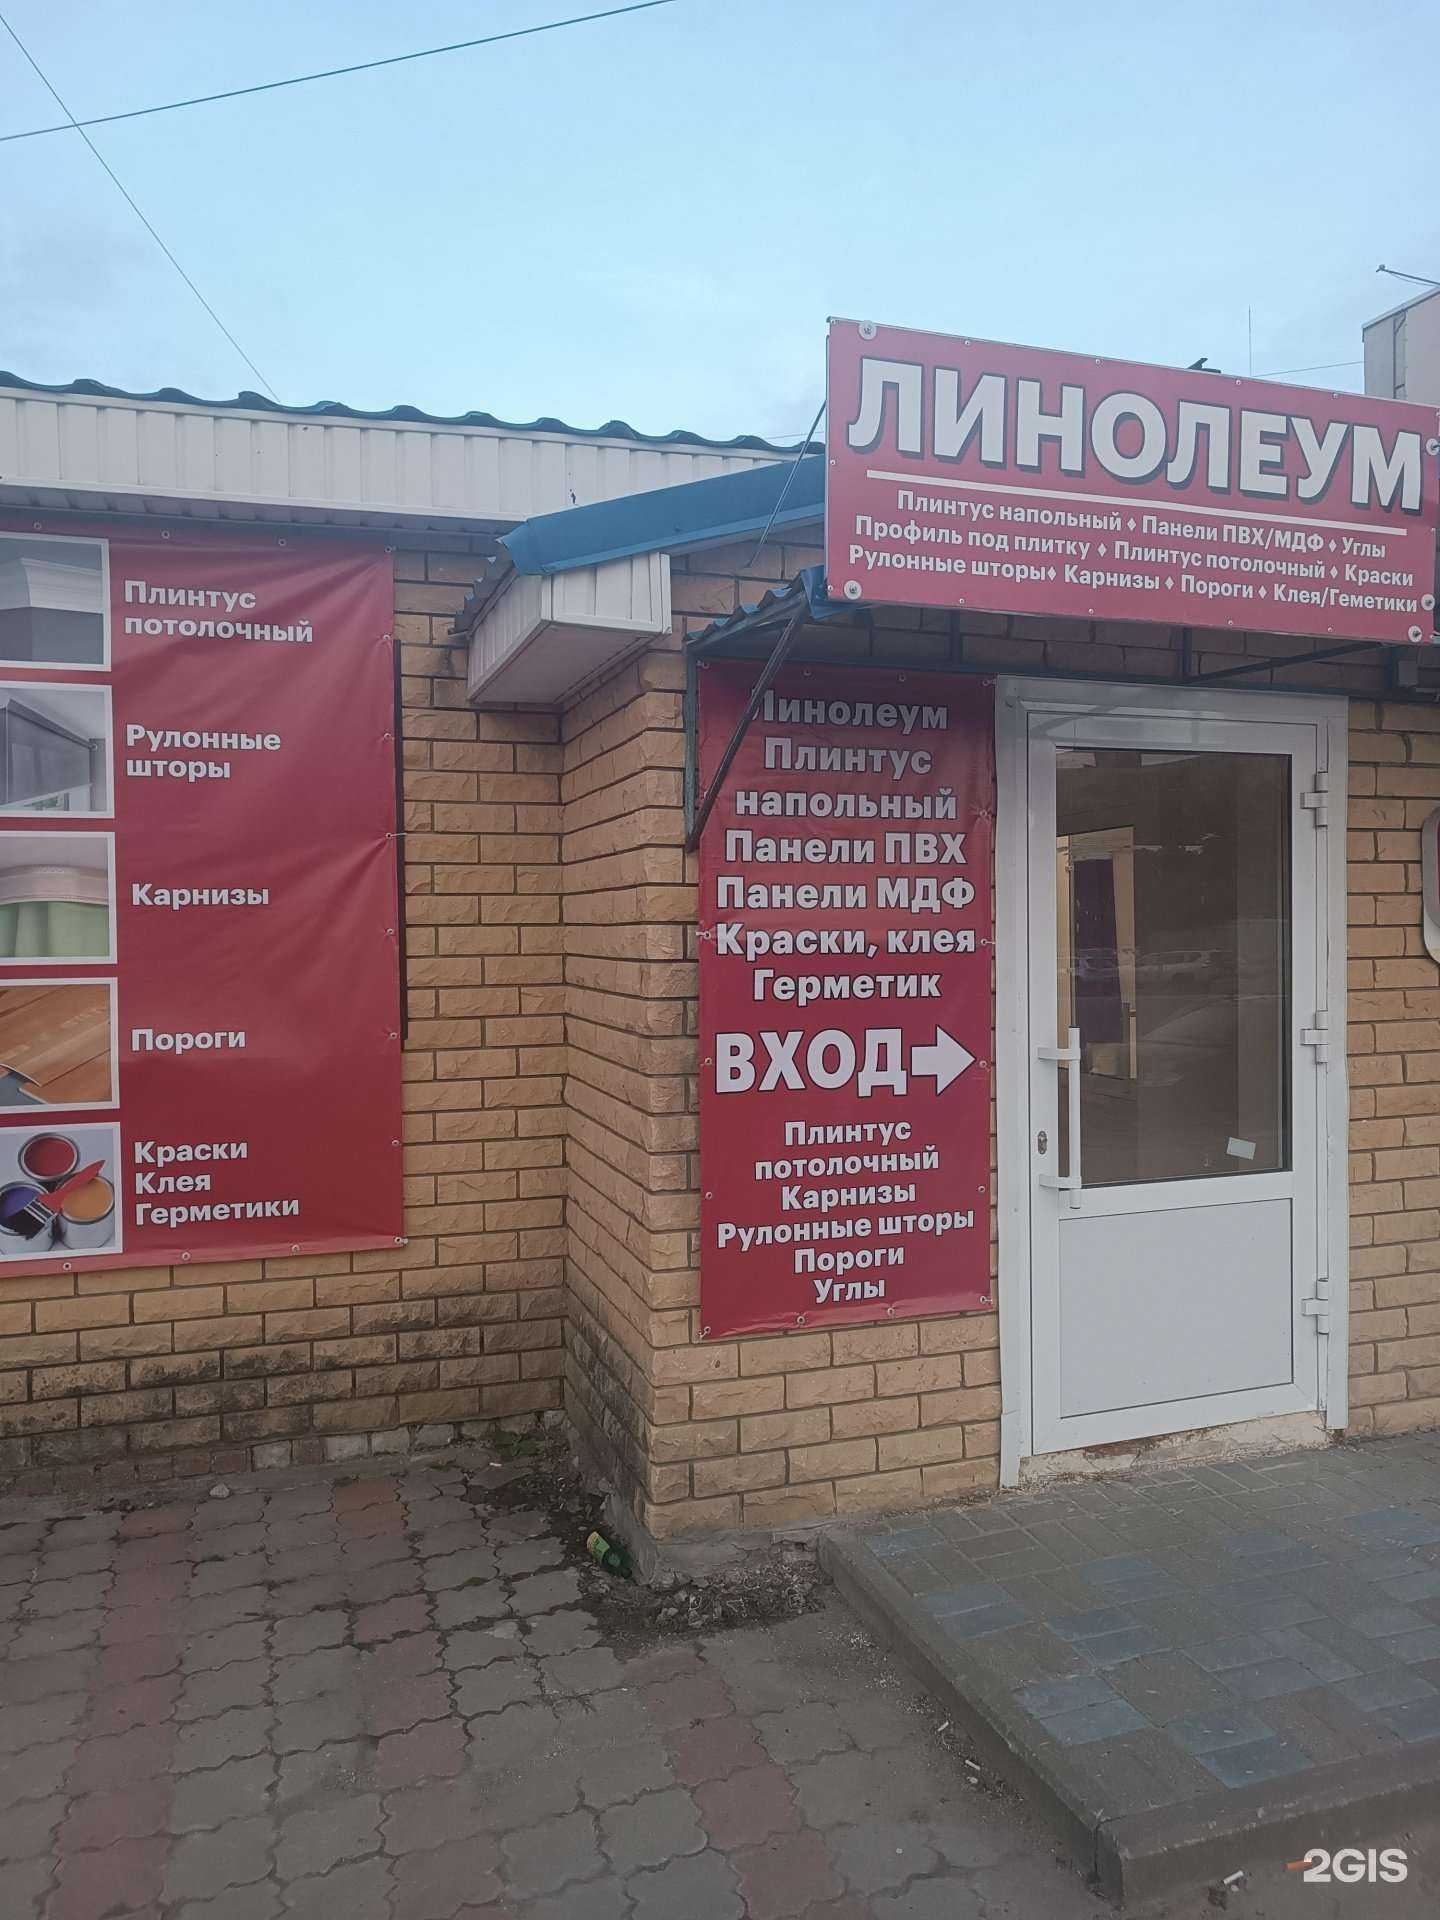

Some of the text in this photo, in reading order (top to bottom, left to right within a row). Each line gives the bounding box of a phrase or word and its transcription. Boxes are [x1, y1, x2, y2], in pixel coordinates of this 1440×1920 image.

[848, 357, 1422, 512] ЛИНОЛЕУМ
[897, 490, 1385, 558] Плинтус напольный Панели ПВХ/МДФ Углы
[855, 515, 1413, 587] Профиль под плитку Плинтус потолочный Краски
[849, 544, 1417, 613] Рулонные шторы Карнизы Пороги Клея/Геметики
[124, 580, 256, 612] Плинтус
[124, 616, 313, 642] потолочный
[126, 724, 281, 752] Рулонные
[126, 758, 230, 782] шторы
[764, 736, 931, 780] Плинтус
[735, 788, 957, 819] напольный
[725, 829, 967, 865] Панели ПВХ
[131, 883, 269, 910] Карнизы
[716, 875, 975, 913] Панели МДФ
[716, 922, 975, 962] Краски, клея
[753, 968, 941, 1006] Герметик
[131, 1029, 246, 1054] Пороги
[715, 1028, 908, 1097] ВХОД
[784, 1121, 912, 1146] Плинтус
[134, 1140, 248, 1168] Краски
[755, 1145, 939, 1180] потолочный
[135, 1171, 211, 1195] Клея
[781, 1184, 916, 1213] Карнизы
[135, 1198, 299, 1227] Герметики
[717, 1210, 974, 1251] Рулонные шторы
[793, 1246, 904, 1275] Пороги
[813, 1278, 885, 1304] Углы
